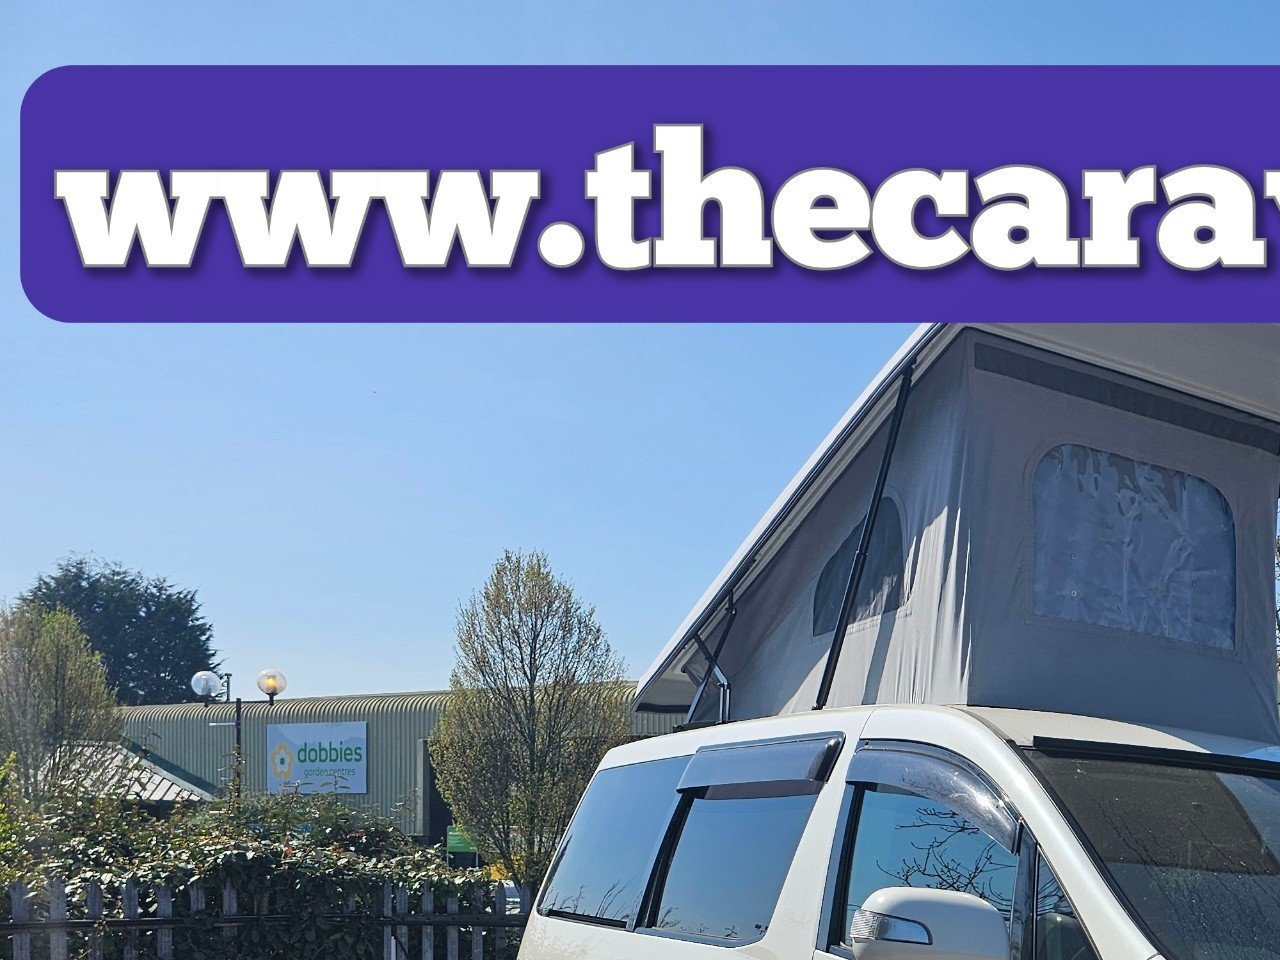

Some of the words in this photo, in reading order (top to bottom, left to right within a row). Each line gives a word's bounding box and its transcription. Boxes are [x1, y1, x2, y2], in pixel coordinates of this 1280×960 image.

[297, 740, 363, 763] dobbies
[304, 767, 327, 779] garden
[328, 767, 356, 776] centres
